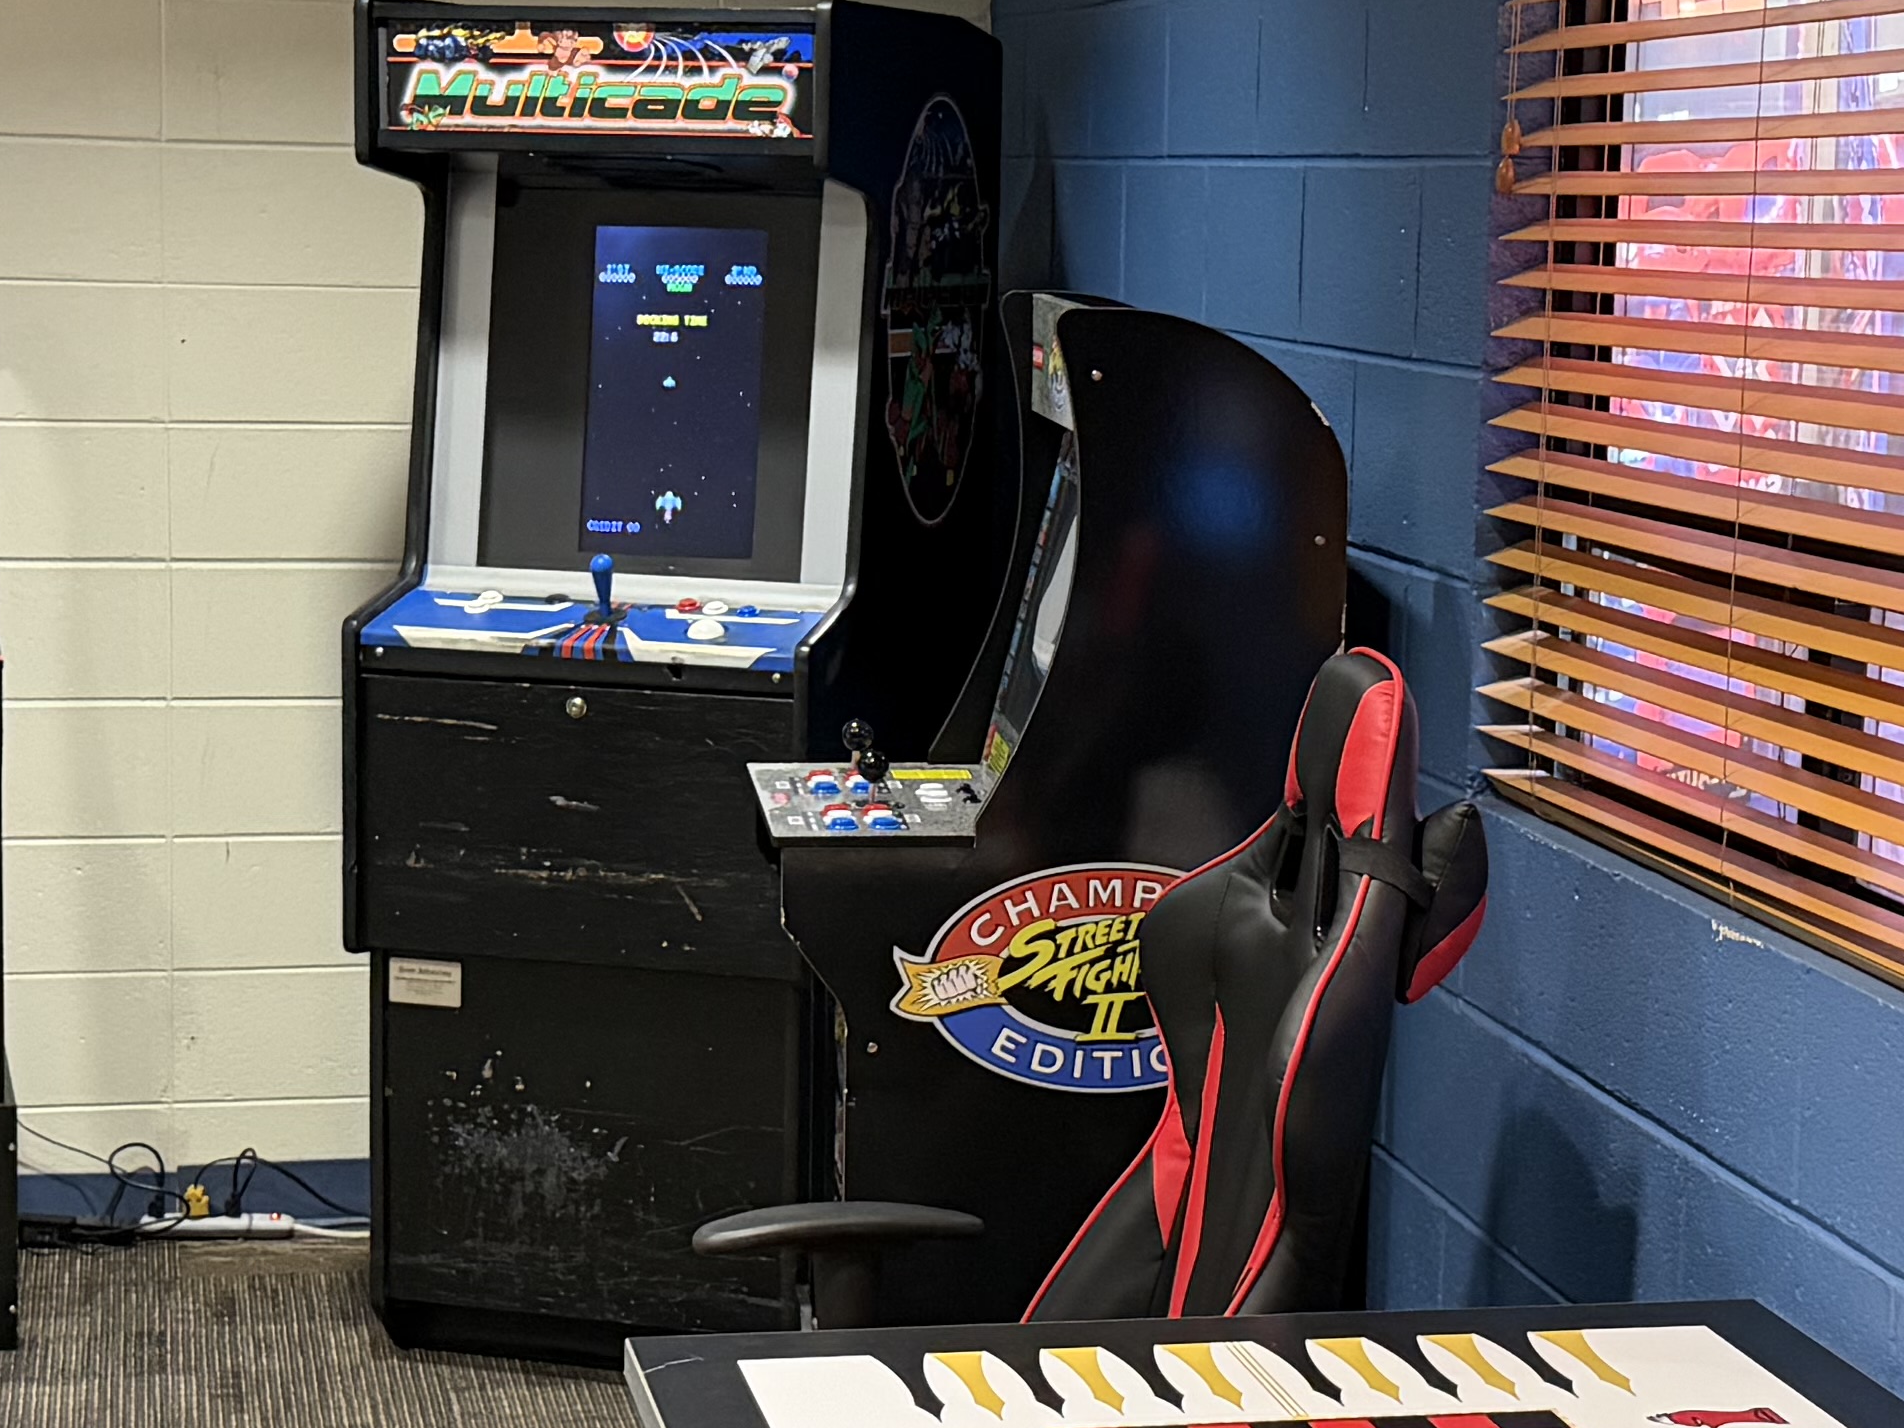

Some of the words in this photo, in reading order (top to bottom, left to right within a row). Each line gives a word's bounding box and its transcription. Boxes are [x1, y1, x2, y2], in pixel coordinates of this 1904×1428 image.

[408, 70, 790, 124] Multicade
[998, 912, 1146, 995] STREET
[1075, 992, 1148, 1042] II
